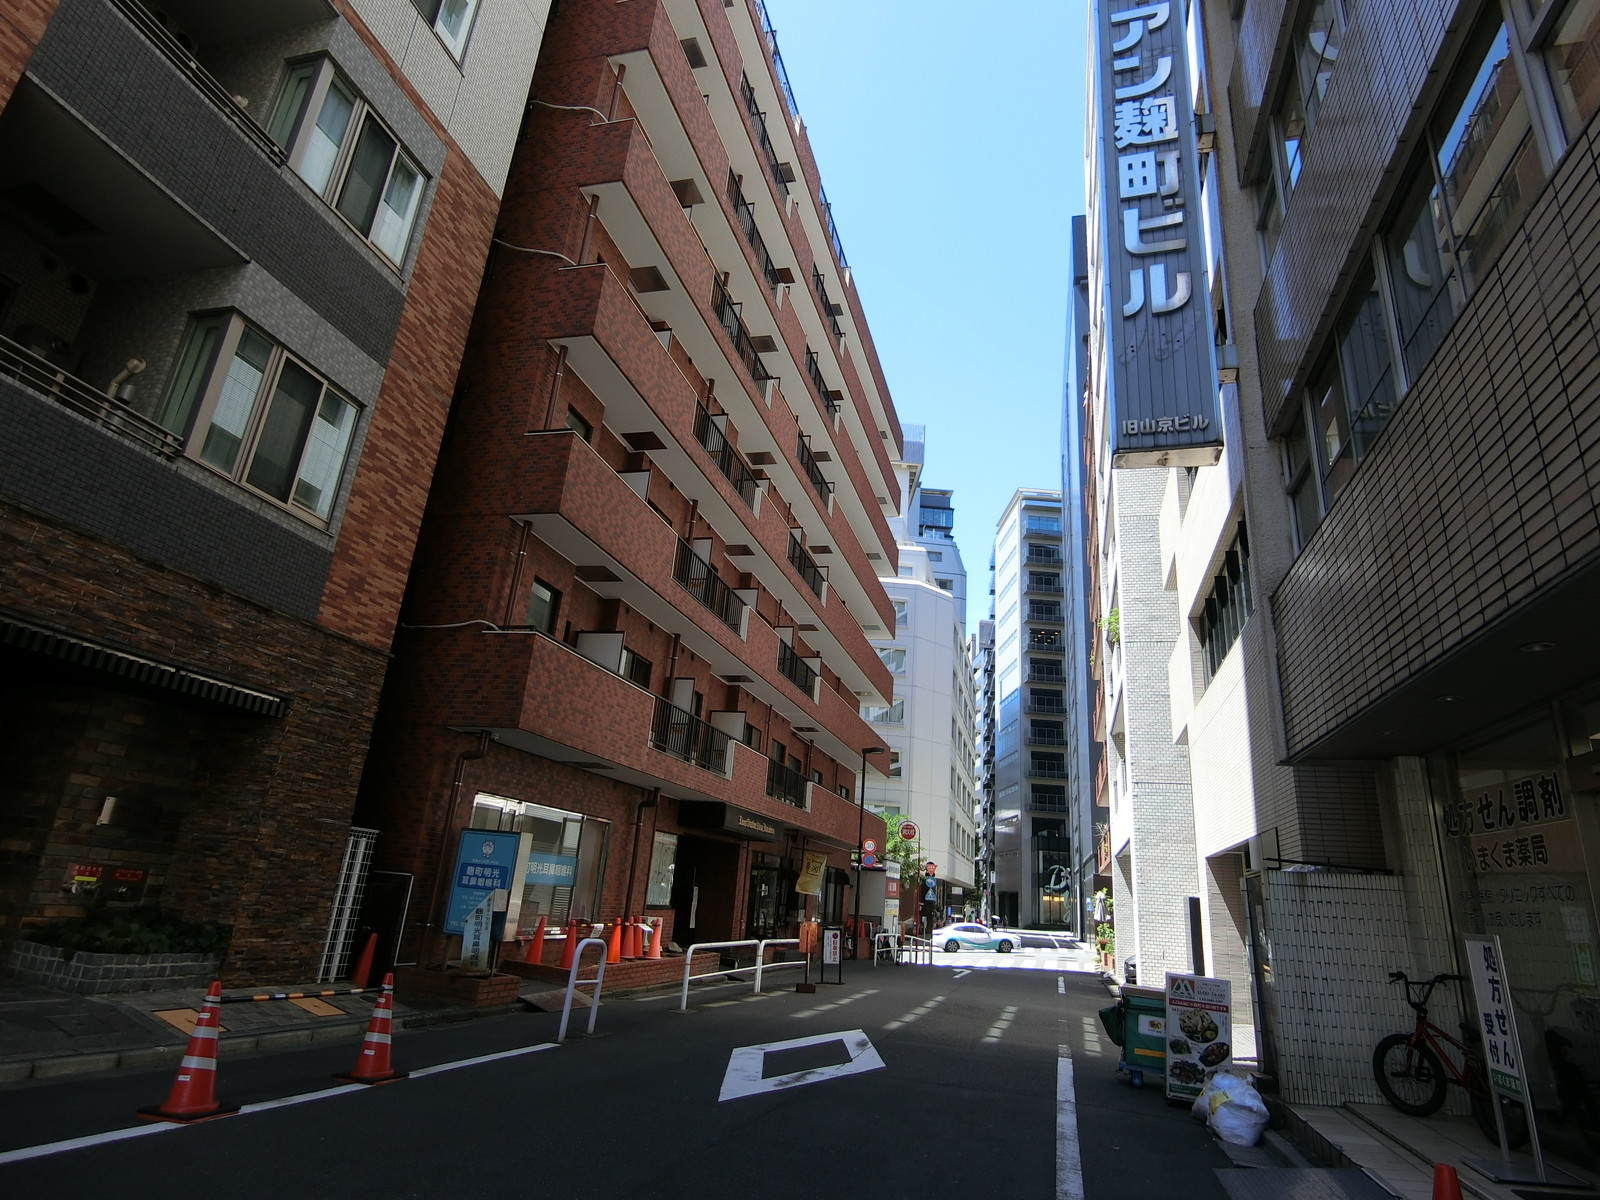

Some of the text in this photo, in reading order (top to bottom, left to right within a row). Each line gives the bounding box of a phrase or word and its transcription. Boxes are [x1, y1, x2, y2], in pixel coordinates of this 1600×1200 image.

[1110, 0, 1192, 317] アン麹町ビル
[1121, 414, 1210, 436] 旧山京ビル
[1443, 772, 1564, 838] 処方せん調剤
[1464, 834, 1549, 872] いまくま薬局
[1482, 944, 1515, 1070] 処方せん
[1484, 1013, 1500, 1064] 受付
